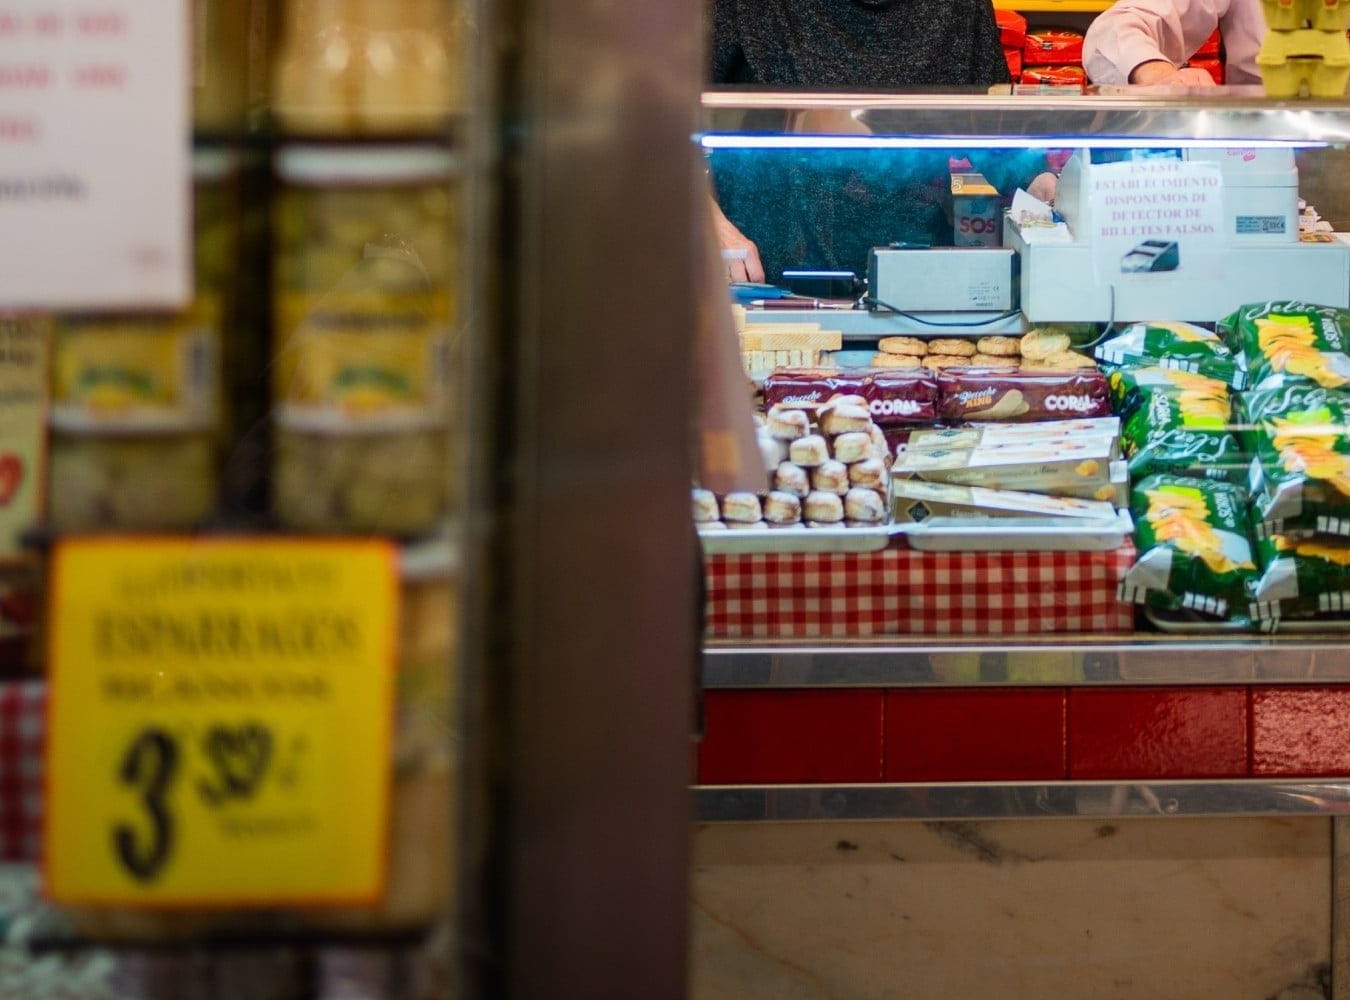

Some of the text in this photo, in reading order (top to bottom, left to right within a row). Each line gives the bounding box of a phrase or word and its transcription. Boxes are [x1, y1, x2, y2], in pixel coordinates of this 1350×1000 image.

[1096, 178, 1218, 190] ESTABLECIMIENTO
[1105, 193, 1208, 205] DISPONEMOS DE
[1112, 208, 1203, 221] DETECTOR DE
[960, 216, 995, 233] SOS
[1101, 223, 1215, 237] BILLETES FALSOS
[870, 399, 921, 415] CORAL
[1045, 394, 1096, 411] CORAL
